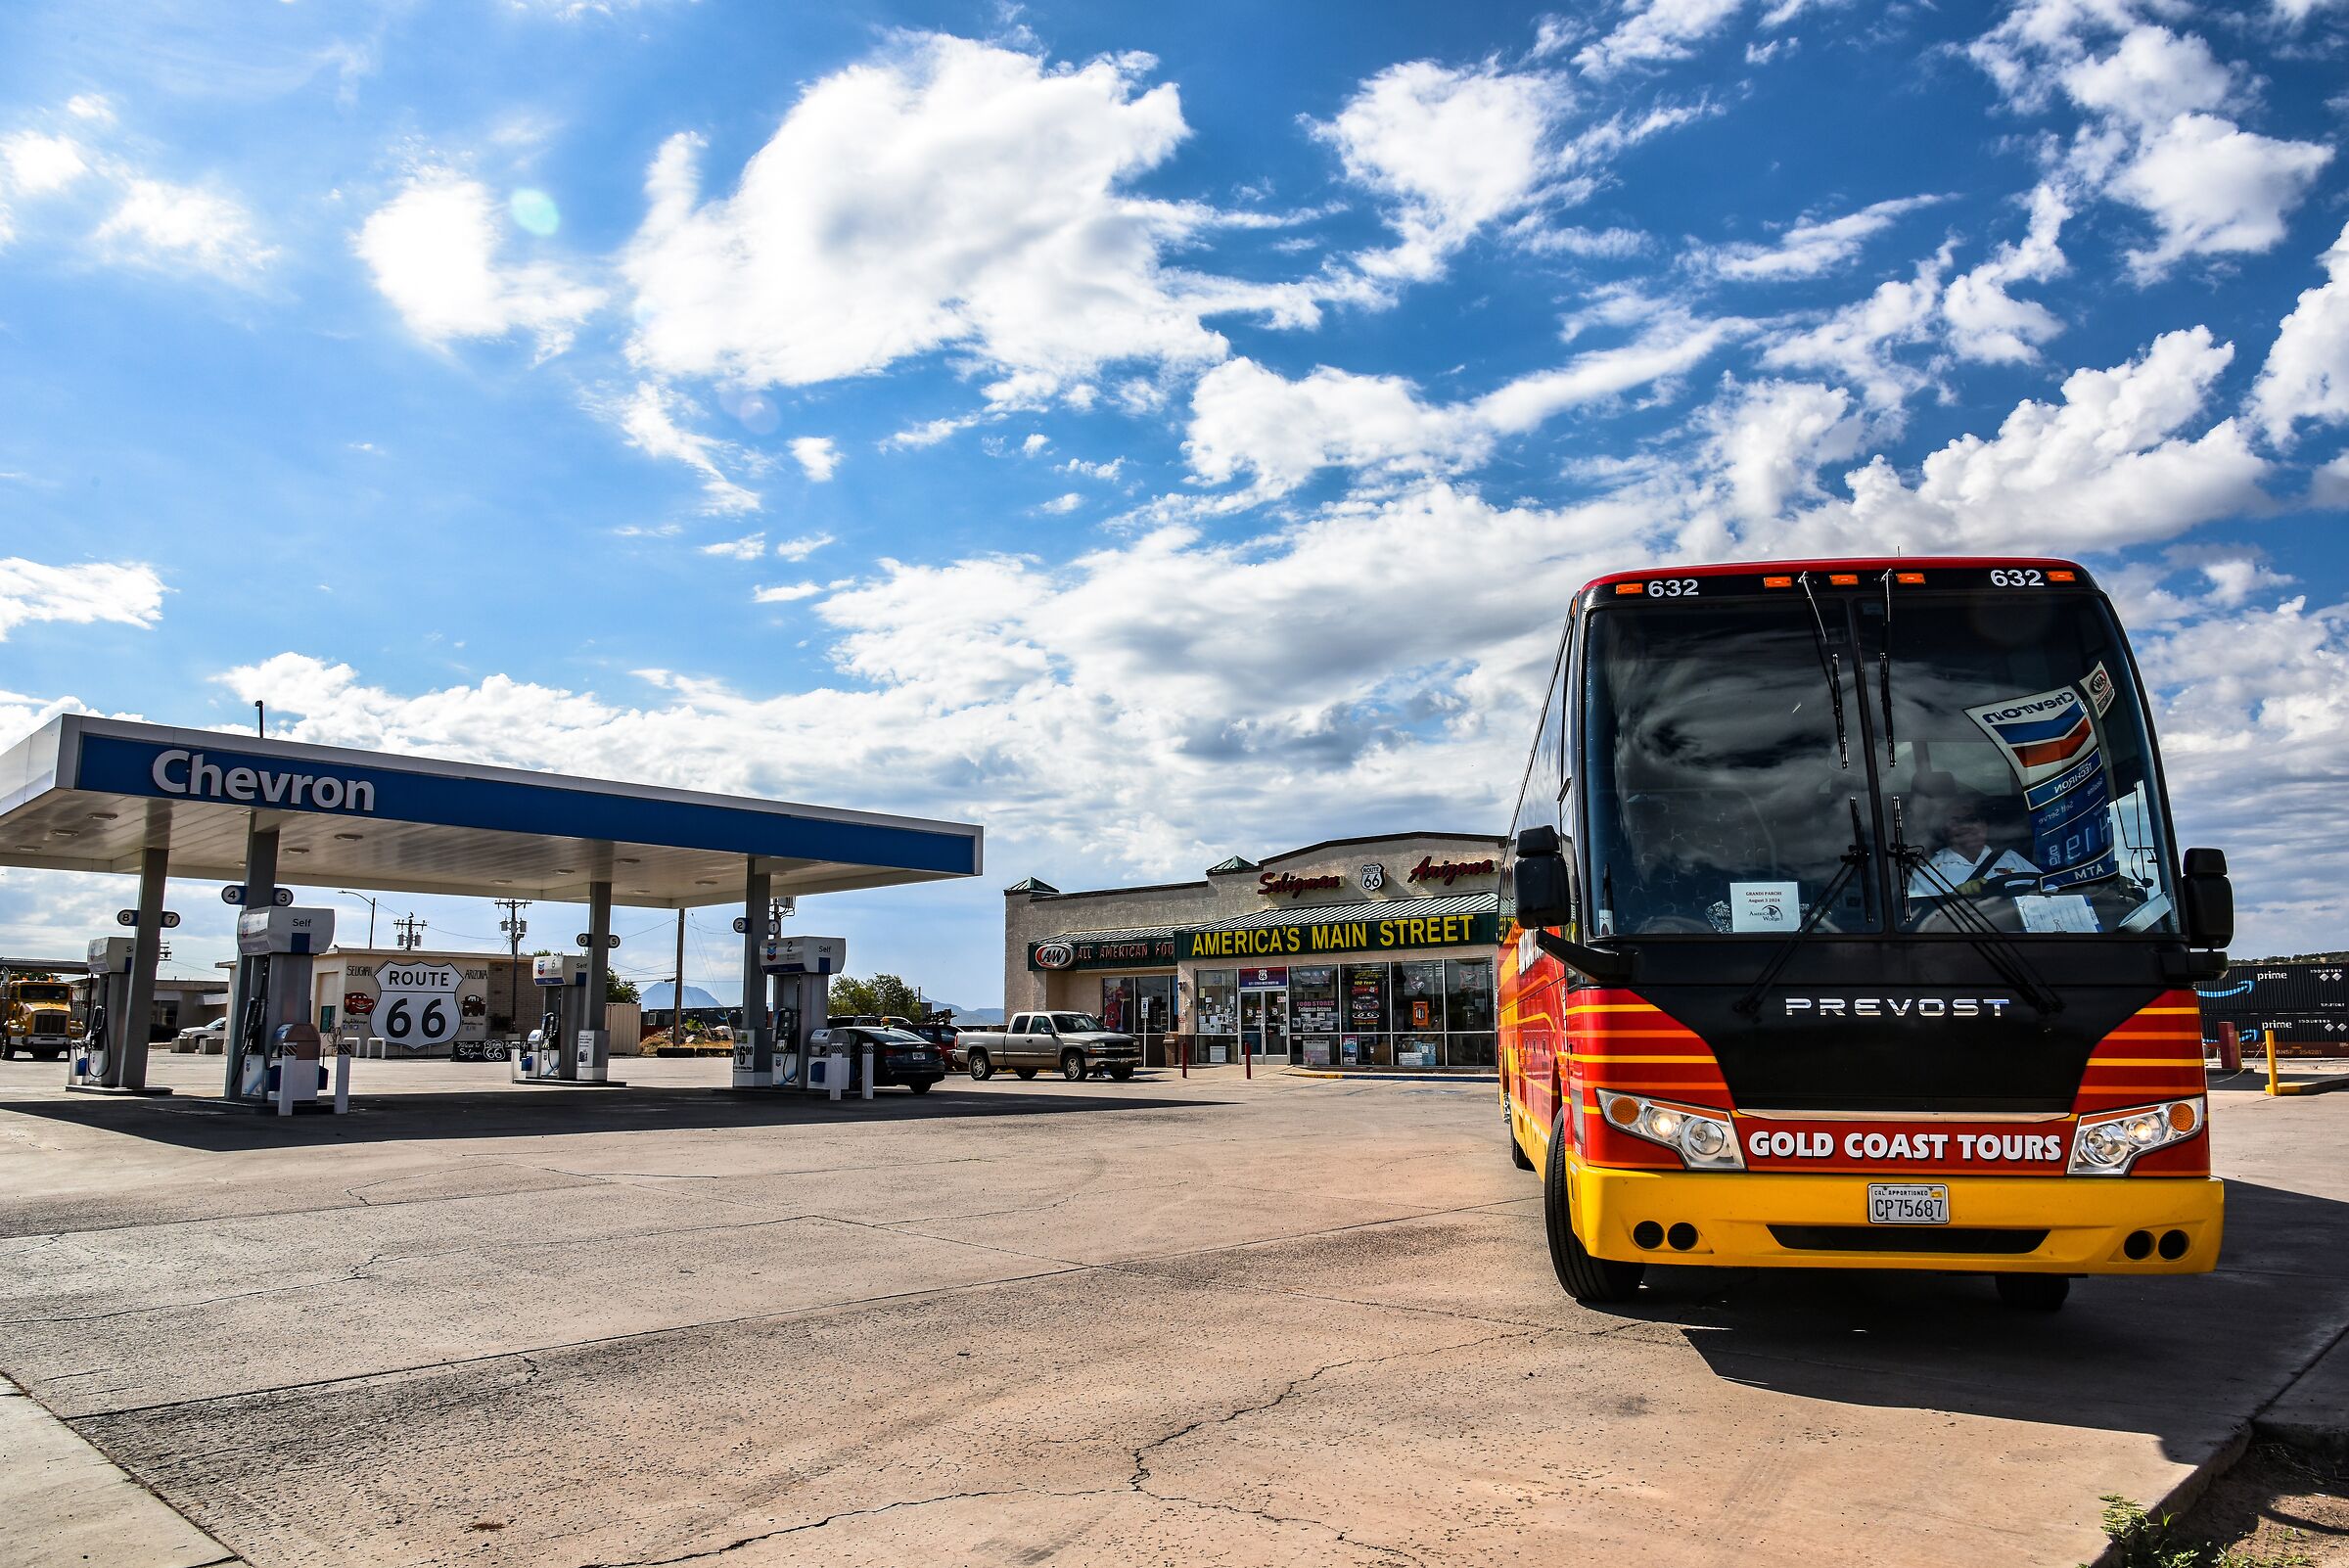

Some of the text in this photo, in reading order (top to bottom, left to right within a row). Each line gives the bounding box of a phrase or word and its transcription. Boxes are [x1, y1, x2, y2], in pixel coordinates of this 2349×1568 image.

[1990, 569, 2045, 587] 632
[1648, 578, 1699, 598] 632
[152, 749, 375, 811] Chevron
[1407, 855, 1496, 886] Arizona
[1258, 871, 1341, 899] Seligman
[1364, 874, 1380, 888] 66
[228, 890, 237, 899] 4
[280, 893, 288, 902] 3
[122, 913, 129, 922] 8
[293, 918, 311, 927] Self
[1191, 915, 1474, 956] AMERICA'S MAIN STREET
[787, 941, 793, 952] 2
[1078, 941, 1174, 959] ALL AMERICAN FOO
[551, 958, 556, 969] 6
[1041, 948, 1065, 963] A&W
[389, 970, 449, 987] ROUTE
[2257, 971, 2287, 981] prime
[1785, 998, 2010, 1017] PREVOST
[387, 998, 446, 1038] 66
[2262, 1020, 2292, 1031] prime
[485, 1048, 503, 1059] 66
[1749, 1130, 2062, 1161] GOLD COAST TOURS
[1875, 1199, 1943, 1218] CP75687
